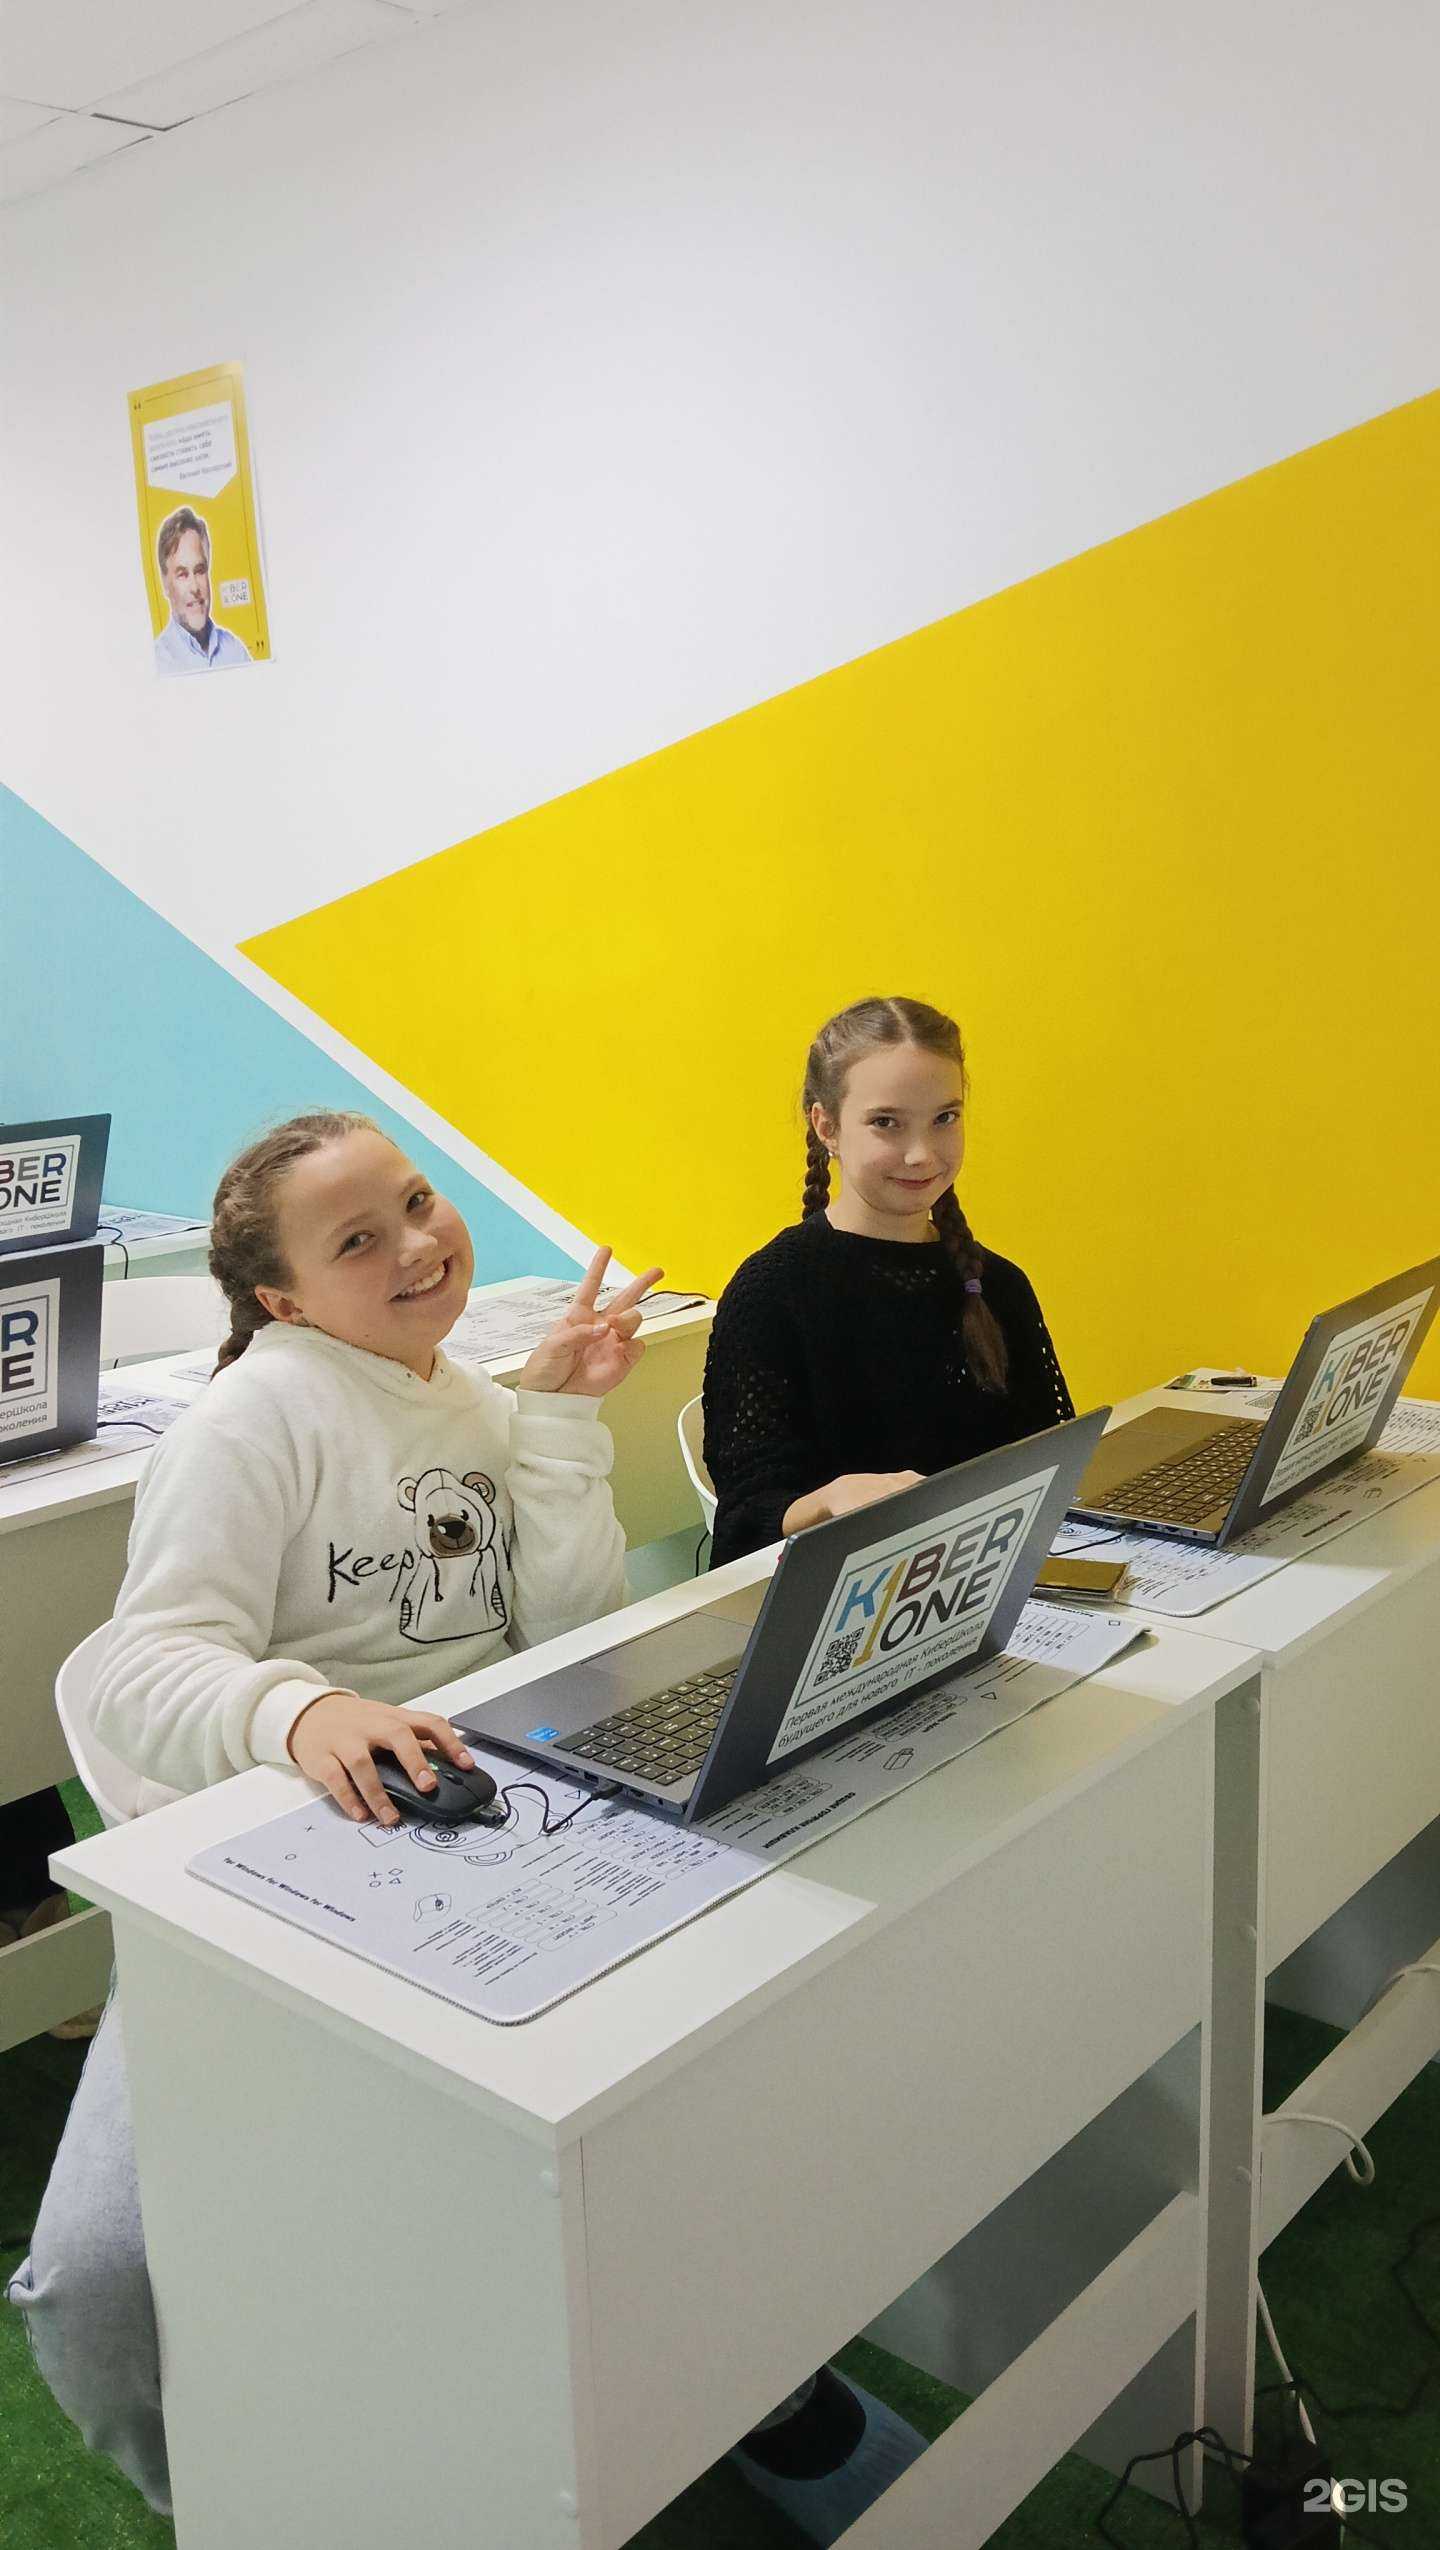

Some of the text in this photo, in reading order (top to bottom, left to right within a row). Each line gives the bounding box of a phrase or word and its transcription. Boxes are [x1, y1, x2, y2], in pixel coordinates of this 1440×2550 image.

[1325, 1363, 1392, 1427] ONE
[328, 1541, 415, 1603] Keep
[879, 1559, 1002, 1652] ONE
[778, 1712, 835, 1749] будущего
[836, 1700, 859, 1721] для
[861, 1678, 899, 1705] нового
[784, 1701, 827, 1731] Первая
[829, 1653, 920, 1709] международная
